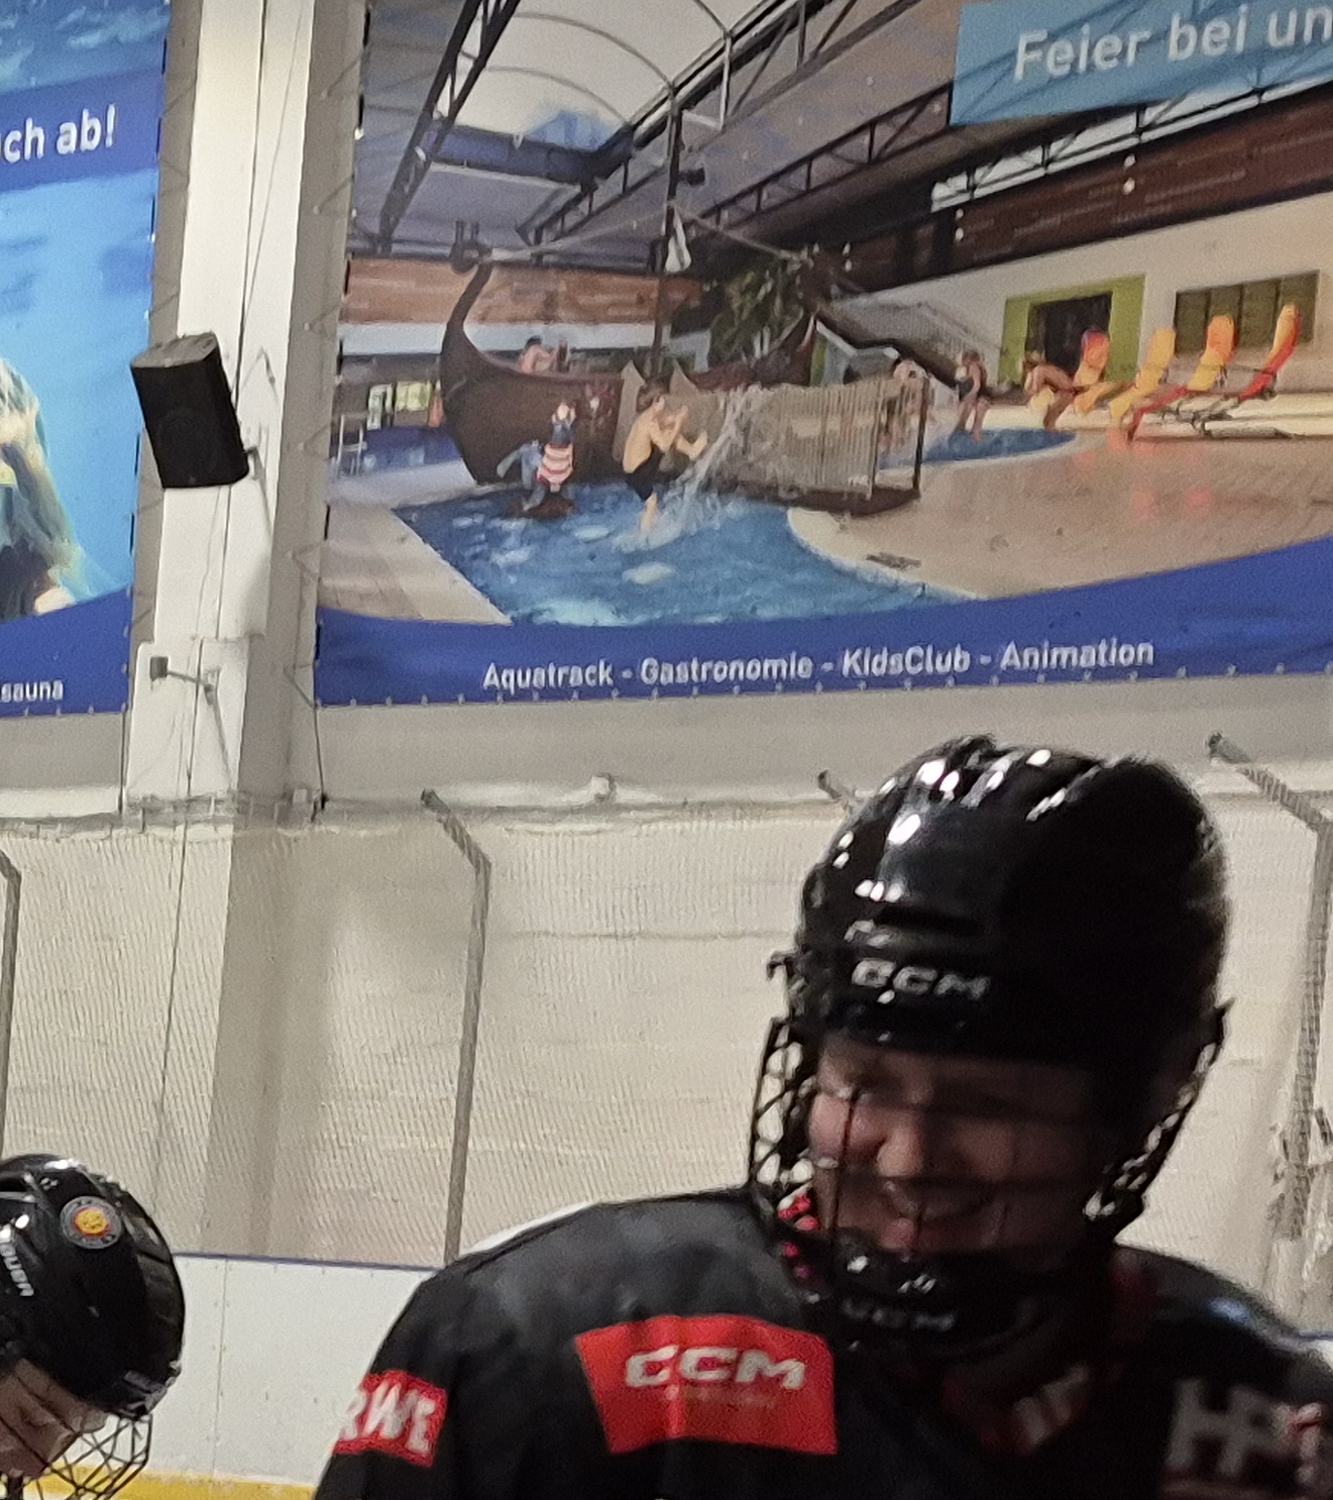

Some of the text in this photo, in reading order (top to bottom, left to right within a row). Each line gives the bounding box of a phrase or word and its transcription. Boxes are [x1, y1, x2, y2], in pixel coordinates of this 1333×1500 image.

[1014, 24, 1151, 84] Feier
[1167, 4, 1249, 62] bei
[56, 105, 119, 157] ab!
[482, 658, 614, 696] Aquatrack
[639, 651, 813, 687] Gastronomie
[842, 643, 971, 678] KidsClub
[999, 636, 1155, 672] Animation
[624, 1344, 807, 1391] CCM
